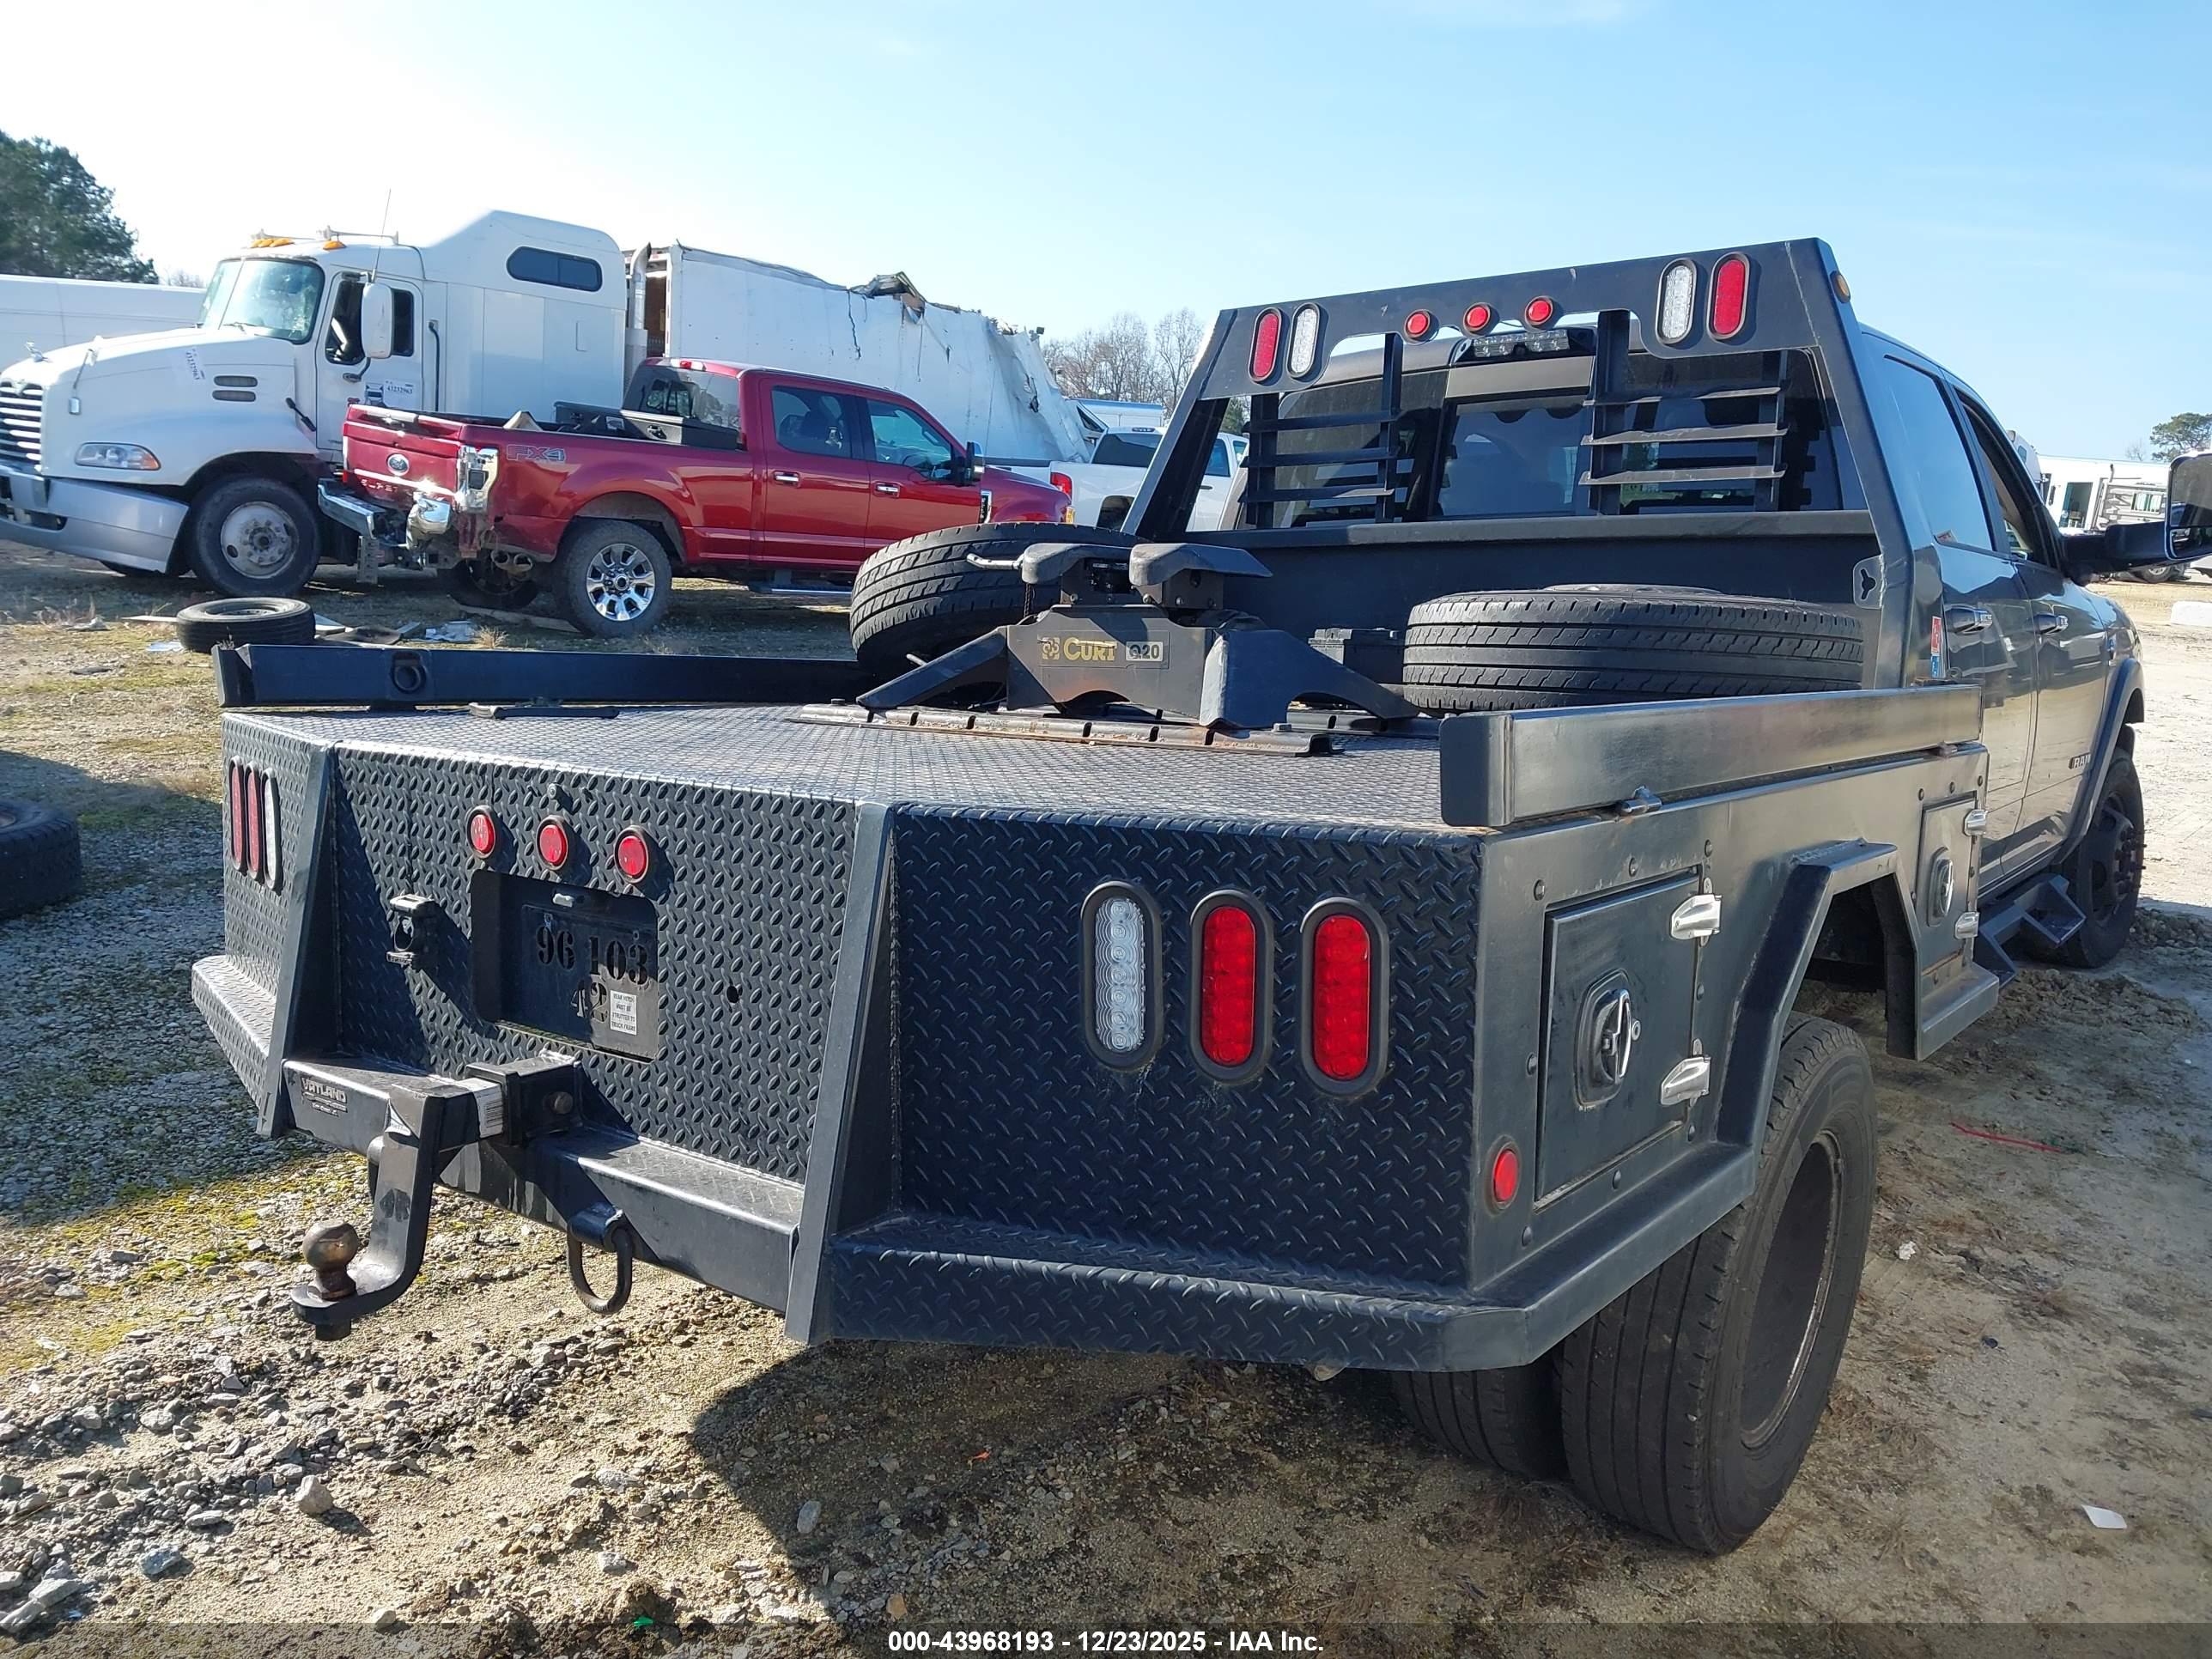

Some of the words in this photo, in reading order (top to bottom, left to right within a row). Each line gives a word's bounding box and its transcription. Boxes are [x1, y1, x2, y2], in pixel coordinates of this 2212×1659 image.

[507, 444, 566, 463] FX4
[1063, 637, 1117, 661] CURT
[1129, 644, 1160, 659] Q20
[536, 926, 575, 970] 96
[589, 936, 649, 986] 103
